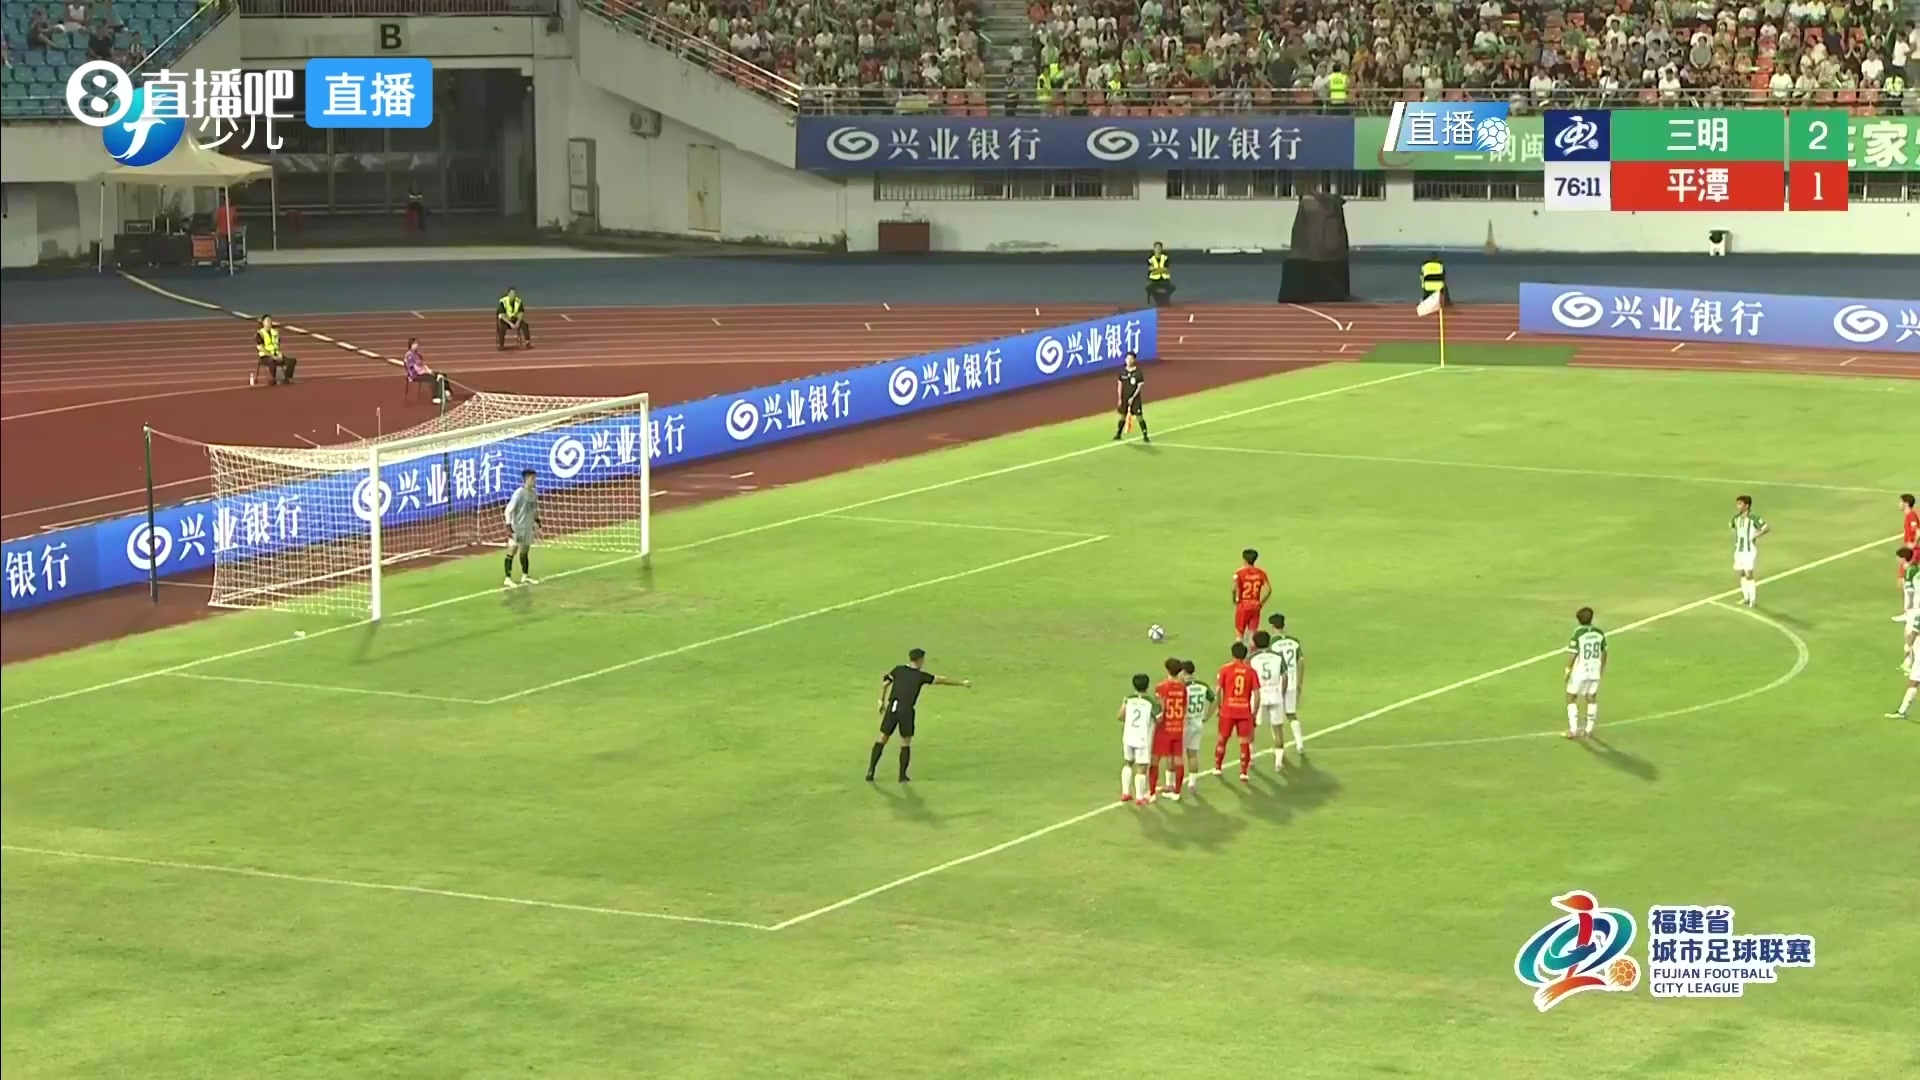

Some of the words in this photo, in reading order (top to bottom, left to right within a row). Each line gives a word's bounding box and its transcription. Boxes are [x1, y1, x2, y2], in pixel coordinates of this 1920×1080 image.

[381, 24, 402, 49] B
[887, 127, 1041, 161] 兴业银行
[1147, 127, 1302, 161] 兴业银行
[1610, 295, 1764, 336] 兴业银行
[1066, 320, 1142, 368] 兴业银行
[921, 348, 1003, 400] 兴业银行
[762, 379, 851, 435] 兴业银行
[396, 451, 504, 513] 兴业银行
[177, 494, 302, 561] 兴业银行
[5, 541, 70, 599] 银行
[1233, 674, 1246, 697] 9
[1261, 662, 1272, 680] 5
[1131, 708, 1142, 728] 2
[1165, 698, 1184, 719] 55
[1187, 694, 1204, 714] 55
